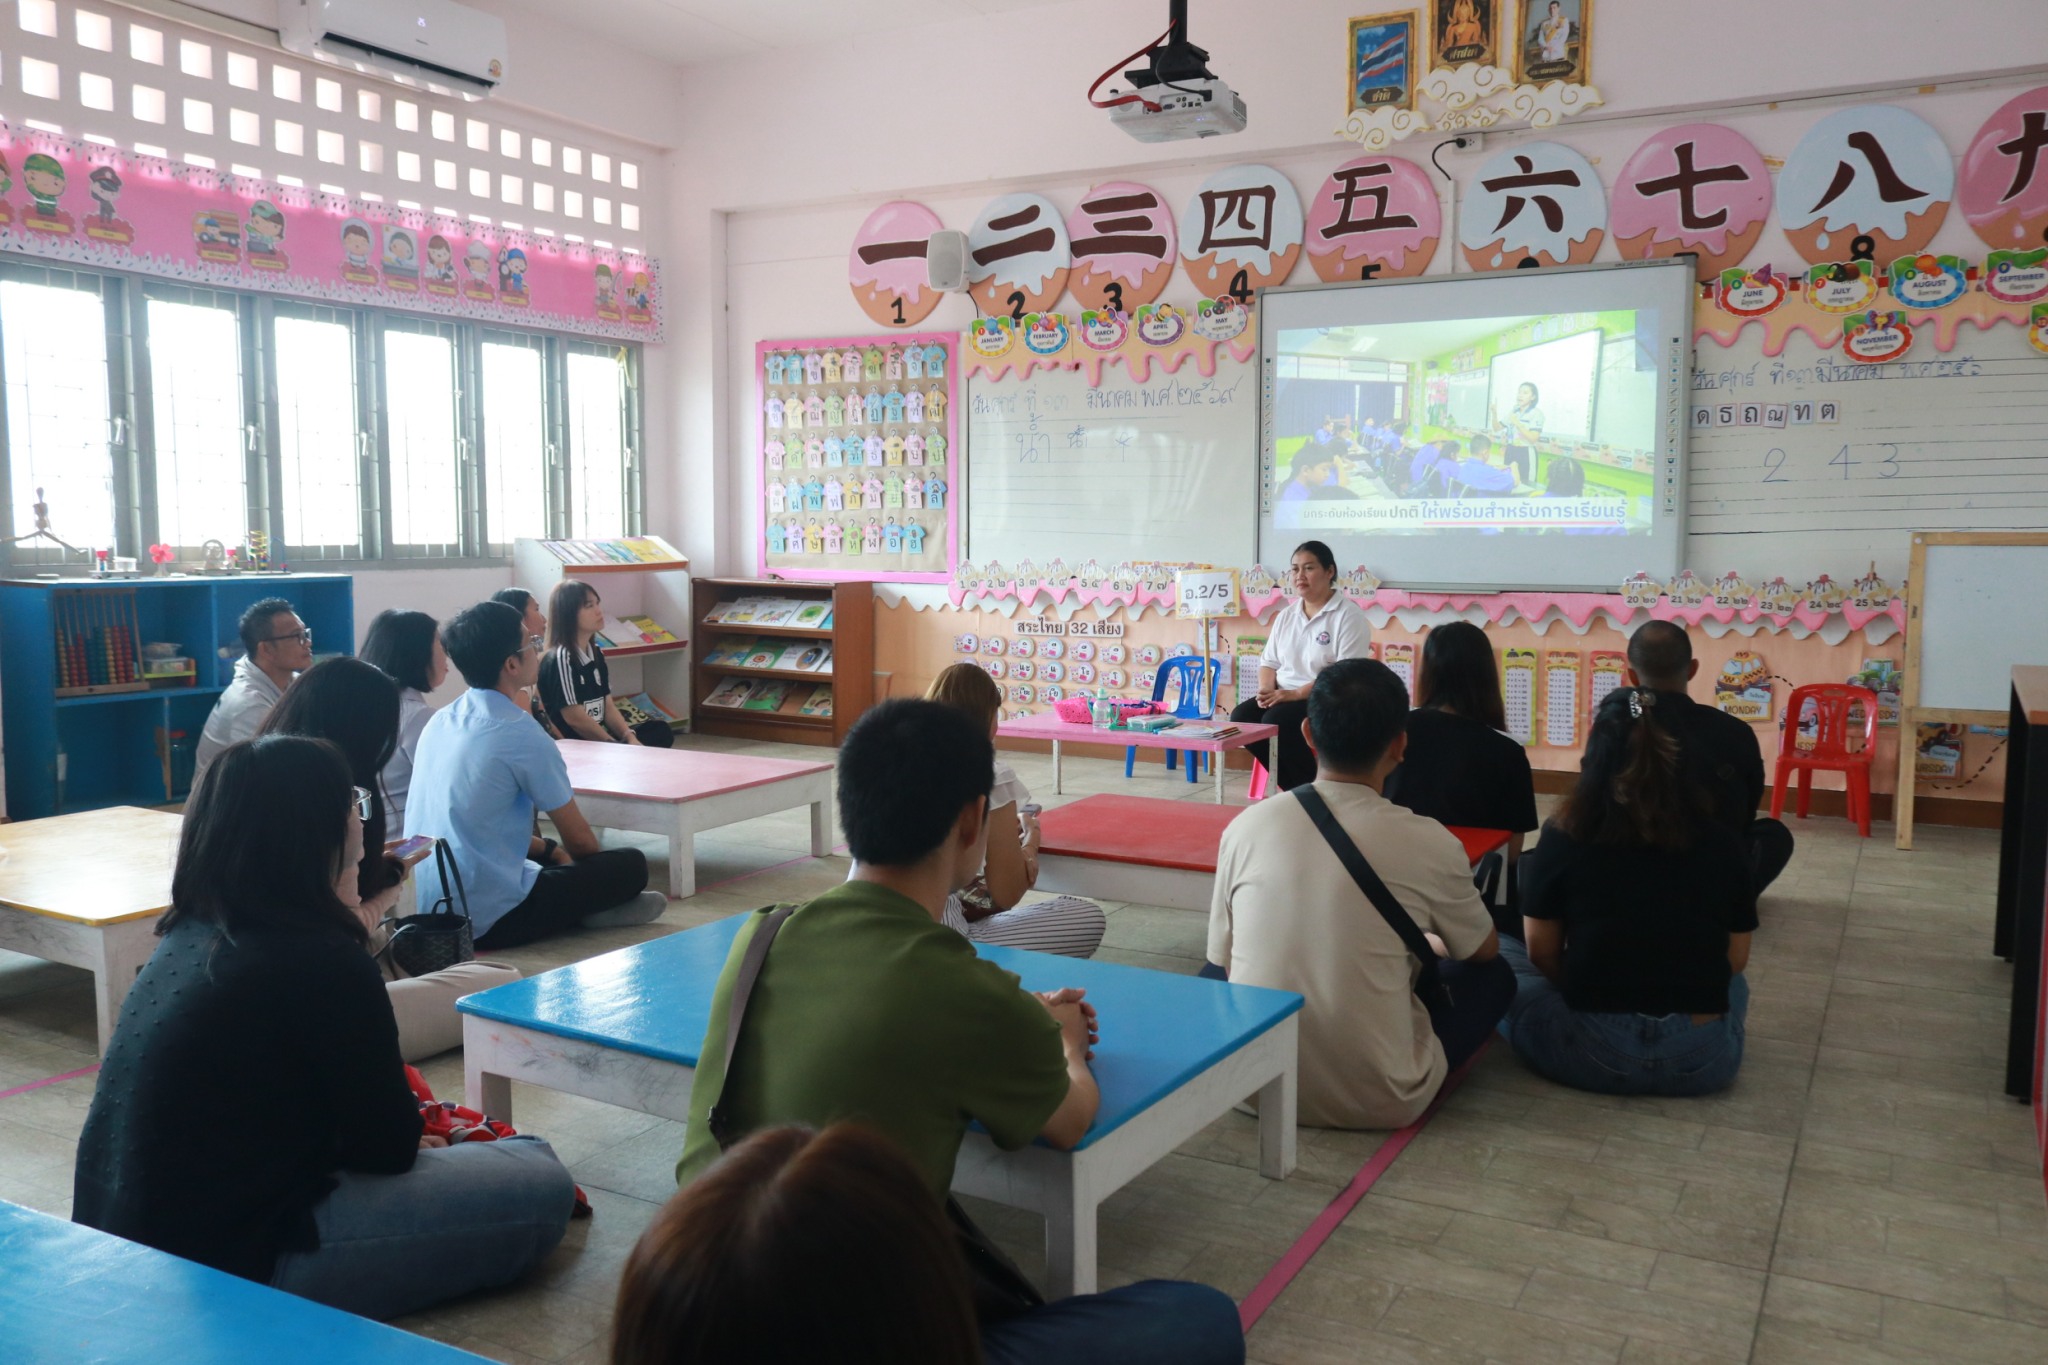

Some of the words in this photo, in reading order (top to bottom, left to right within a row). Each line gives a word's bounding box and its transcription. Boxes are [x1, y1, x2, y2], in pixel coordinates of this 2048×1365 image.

[1808, 131, 1931, 214] 八
[1635, 141, 1750, 229] 七
[1481, 155, 1581, 234] 六
[1320, 163, 1418, 239] 五
[1198, 185, 1276, 253] 四
[1070, 192, 1167, 259] 三
[972, 204, 1056, 267] 二
[1999, 273, 2045, 282] SEPTEMBER
[1229, 269, 1254, 304] 4
[1912, 279, 1947, 289] AUGUST
[1742, 289, 1763, 298] JUNE
[1831, 287, 1851, 295] JULY
[1103, 282, 1123, 311] 3
[889, 297, 907, 324] 1
[1008, 291, 1027, 320] 2
[1215, 317, 1228, 325] MAY
[980, 336, 1004, 344] JANUARY
[1856, 334, 1899, 345] NOVEMBER
[1086, 388, 1137, 408] มีนาคม
[1697, 410, 1709, 424] ด
[1720, 406, 1733, 423] ธ
[1745, 406, 1758, 423] ถ
[1768, 409, 1783, 422] ณ
[1795, 404, 1810, 421] ท
[1821, 403, 1835, 420] ต
[1762, 448, 1790, 483] 2
[1828, 444, 1862, 480] 4
[1879, 443, 1901, 478] 3
[1389, 504, 1419, 519] ปกติ
[1420, 499, 1628, 525] ให้พร้อมสำหรับการเรียนรู้
[960, 580, 966, 588] 1
[987, 580, 994, 588] 2
[1019, 579, 1025, 587] 3
[1048, 578, 1055, 587] 4
[1081, 580, 1087, 588] 5
[1113, 581, 1120, 590] 6
[1147, 581, 1153, 590] 7
[1185, 583, 1229, 600] อ.2/5
[1246, 586, 1255, 594] 10
[1626, 596, 1639, 604] 20
[1671, 595, 1682, 604] 21
[1716, 596, 1729, 604] 22
[1855, 599, 1868, 607] 25
[1760, 601, 1773, 610] 23
[1017, 616, 1063, 634] สระไทย
[1071, 622, 1089, 635] 32
[1093, 617, 1122, 635] เสียง
[1724, 705, 1762, 715] MONDAY
